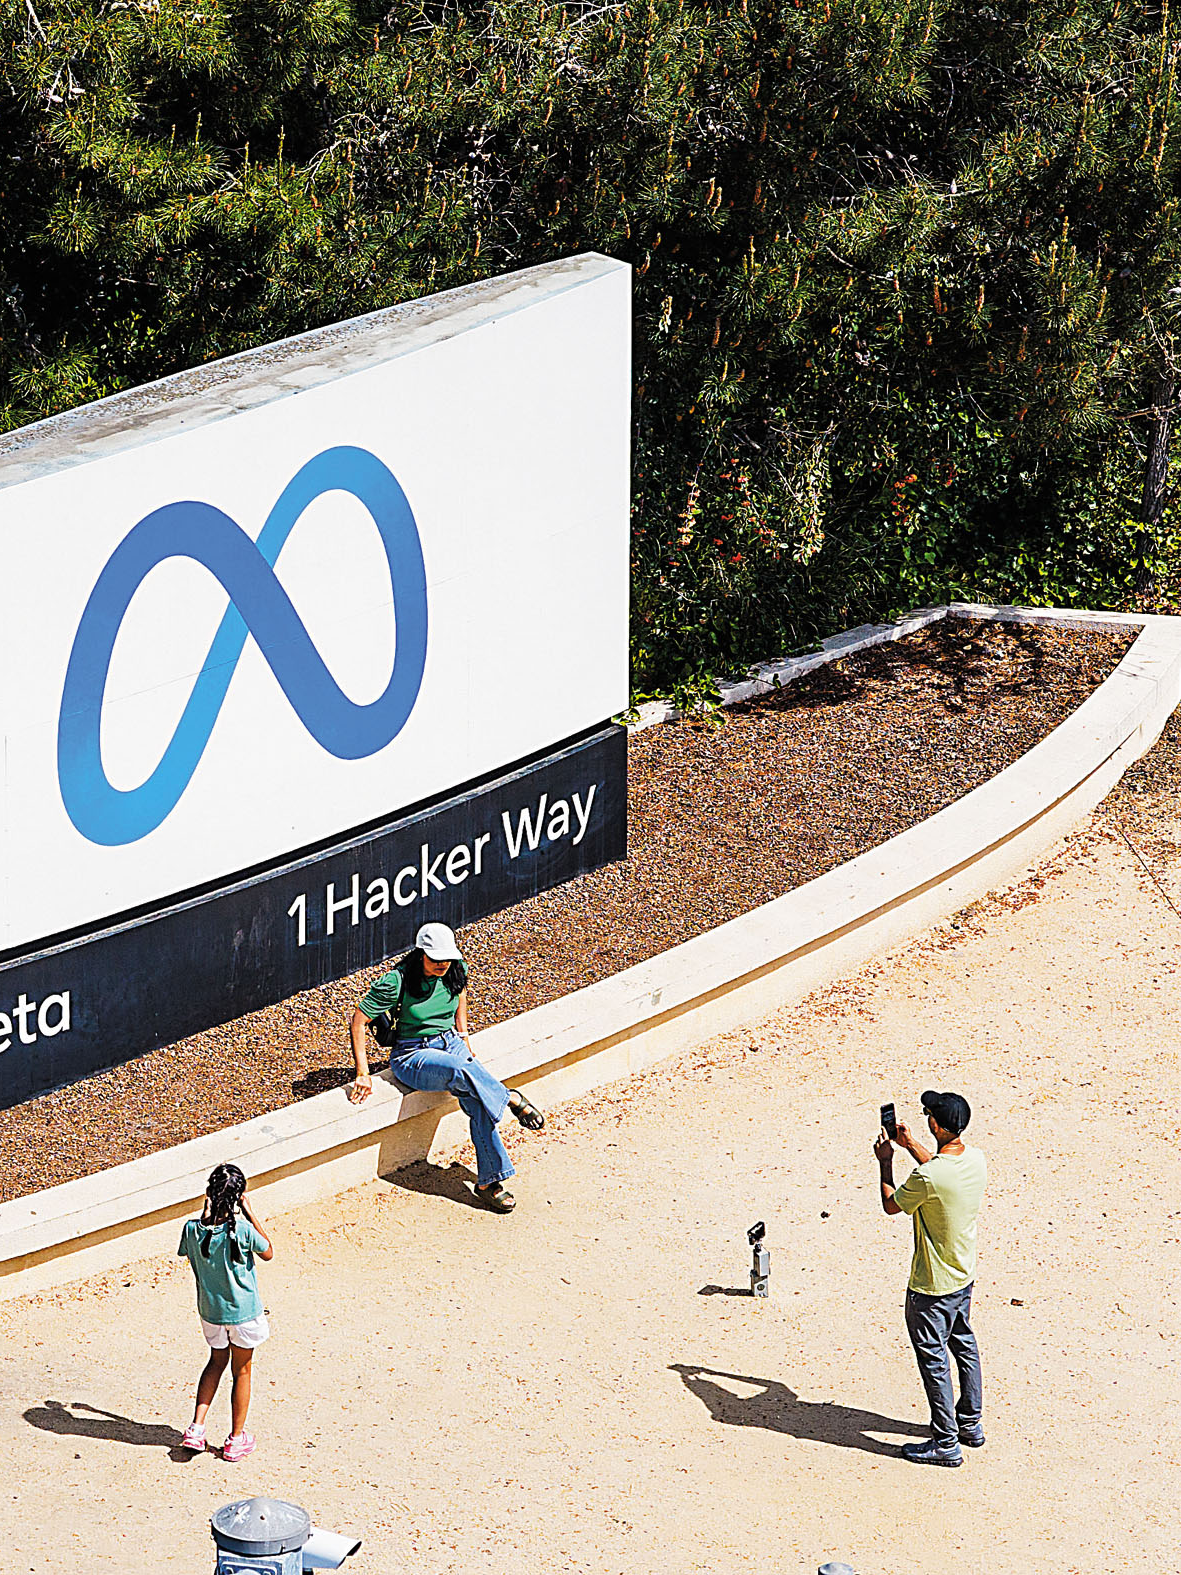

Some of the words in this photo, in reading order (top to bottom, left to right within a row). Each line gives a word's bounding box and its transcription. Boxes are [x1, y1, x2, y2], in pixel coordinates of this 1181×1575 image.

[287, 893, 306, 947] 1
[326, 832, 491, 935] Hacker
[501, 784, 597, 860] Way
